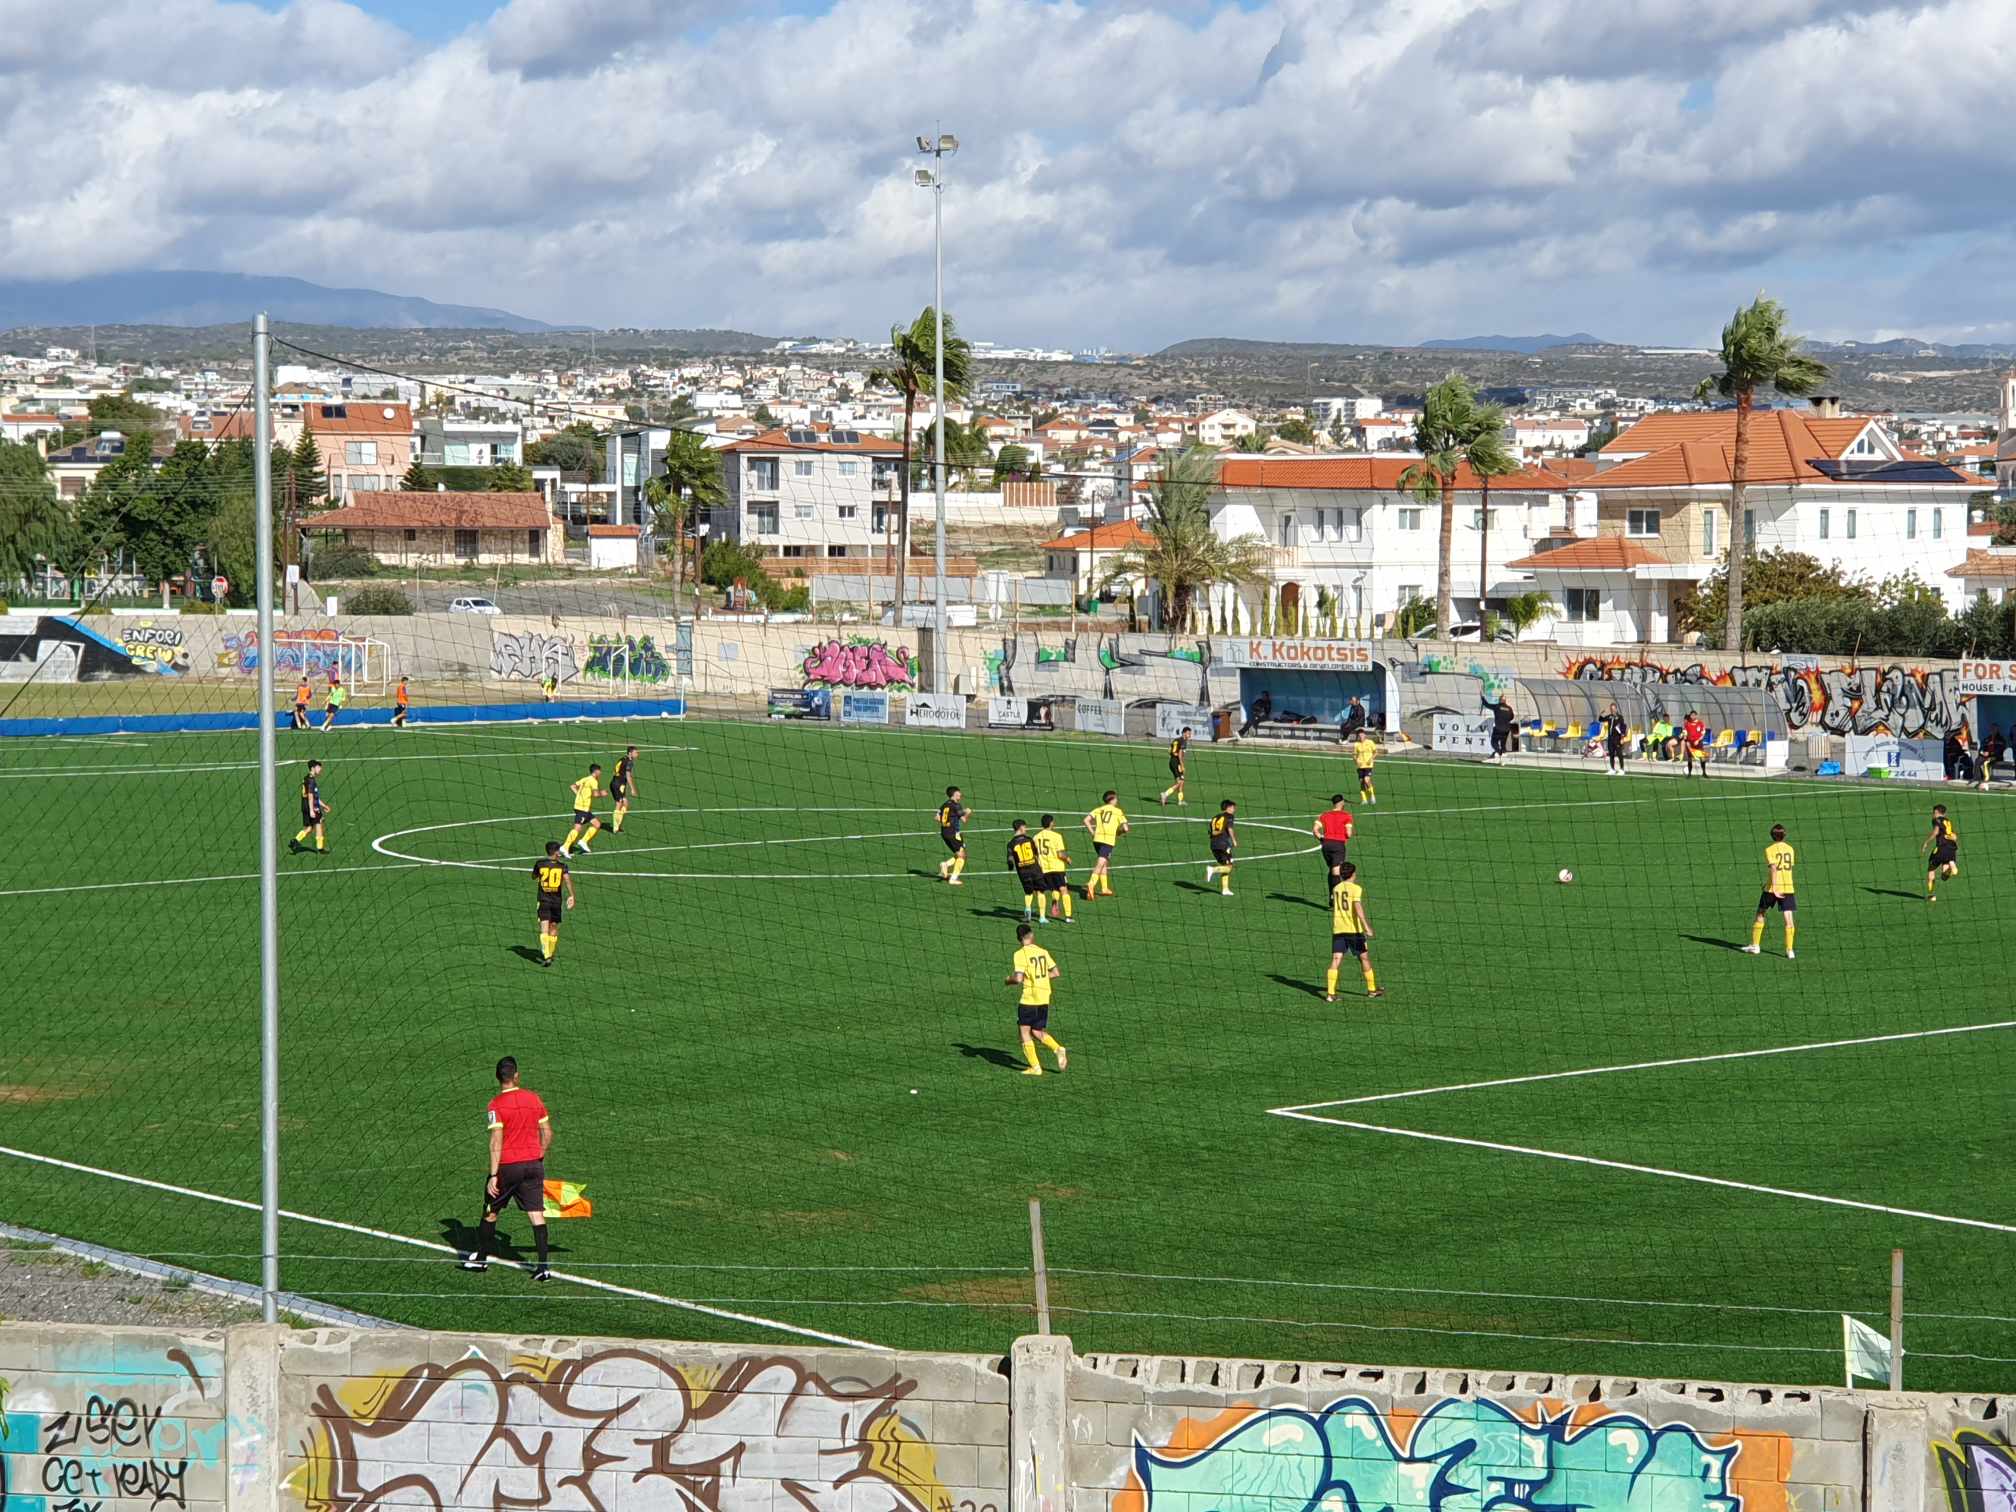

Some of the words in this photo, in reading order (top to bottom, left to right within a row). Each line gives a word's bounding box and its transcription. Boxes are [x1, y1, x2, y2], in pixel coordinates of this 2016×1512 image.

[126, 644, 175, 664] CREW
[1249, 640, 1267, 661] K.
[1271, 641, 1369, 663] Kokotsis
[1248, 661, 1303, 669] CONSTRUCTORS
[1962, 663, 2001, 680] FOR
[1961, 683, 1995, 692] HOUSE
[1438, 723, 1488, 732] VOLV
[1439, 736, 1486, 746] PENT
[1100, 810, 1113, 824] 10
[1014, 842, 1034, 861] 16
[1038, 838, 1050, 856] 15
[1776, 852, 1792, 871] 29
[539, 867, 562, 888] 20
[1335, 891, 1349, 911] 16
[1030, 955, 1047, 979] 20
